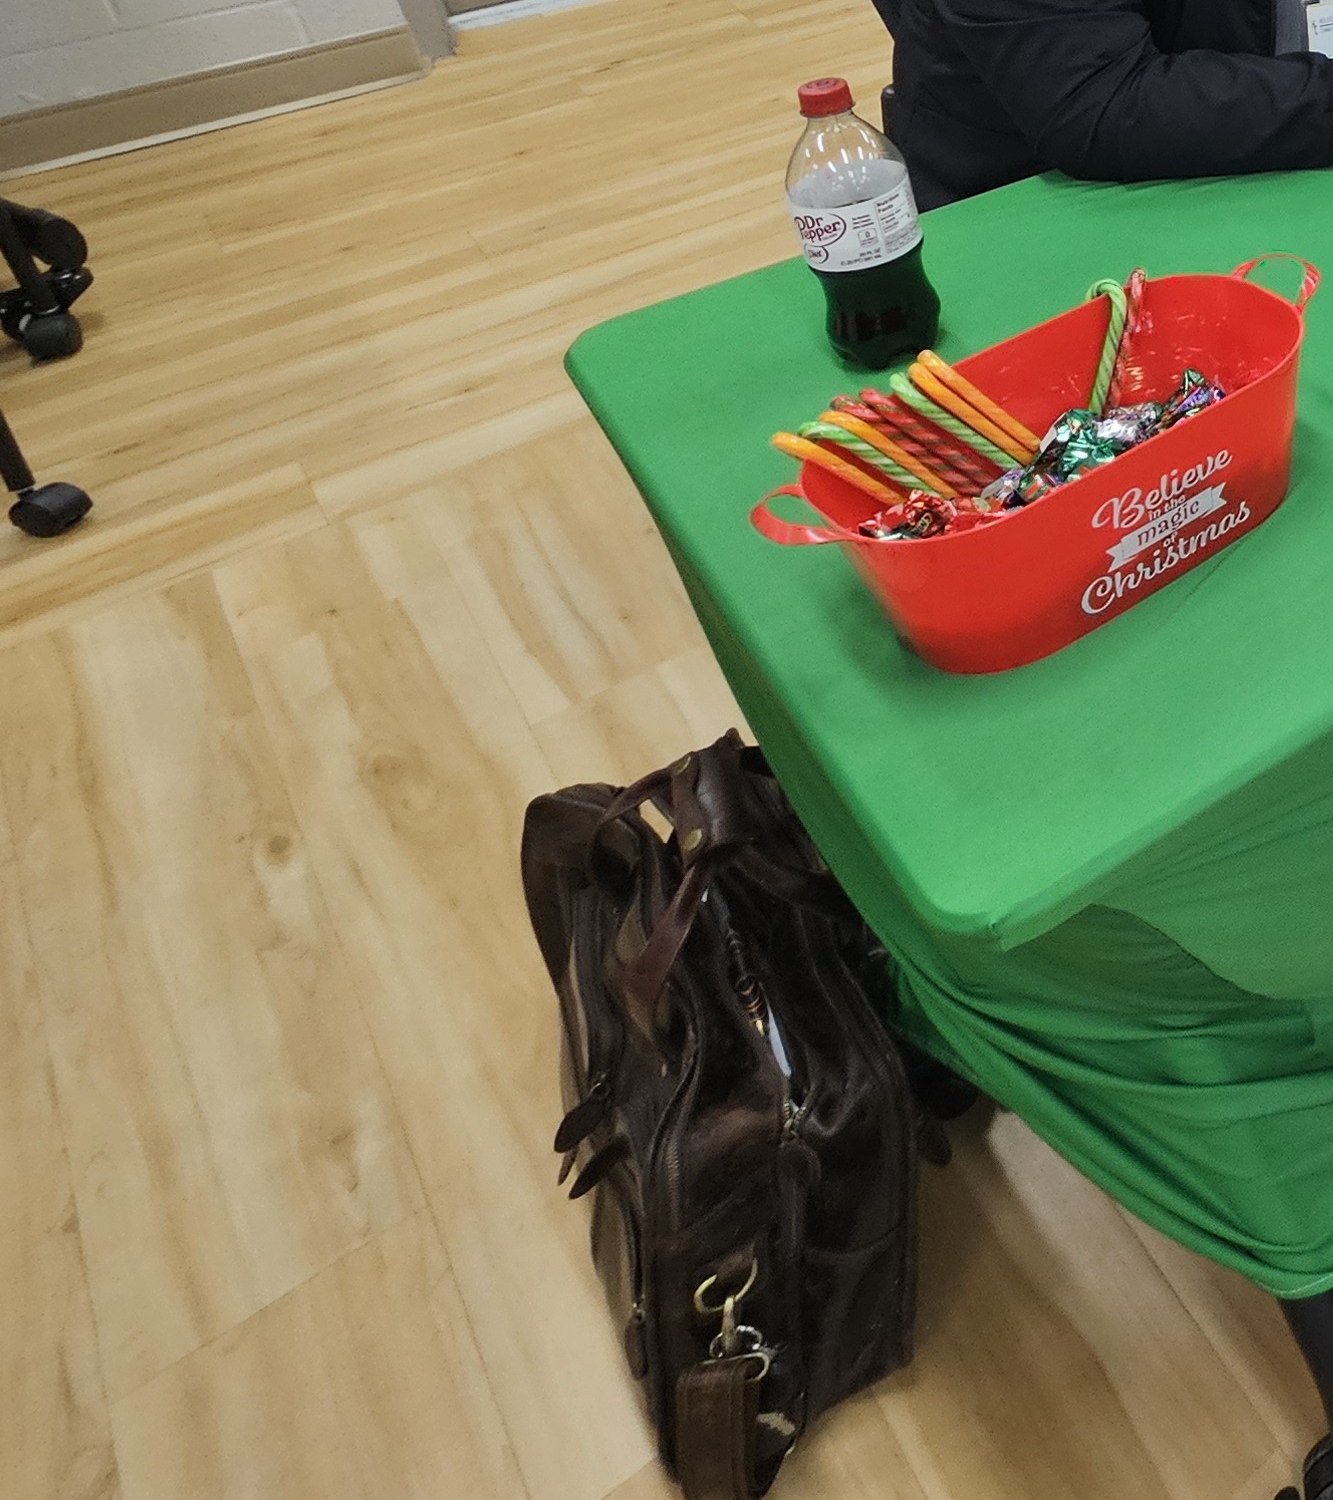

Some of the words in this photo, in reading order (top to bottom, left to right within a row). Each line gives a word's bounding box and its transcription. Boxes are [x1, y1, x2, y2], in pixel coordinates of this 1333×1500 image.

[1091, 449, 1233, 530] Believe
[1148, 508, 1161, 522] in
[1164, 493, 1186, 514] the
[1137, 500, 1200, 547] magic
[1081, 500, 1252, 615] Christmas
